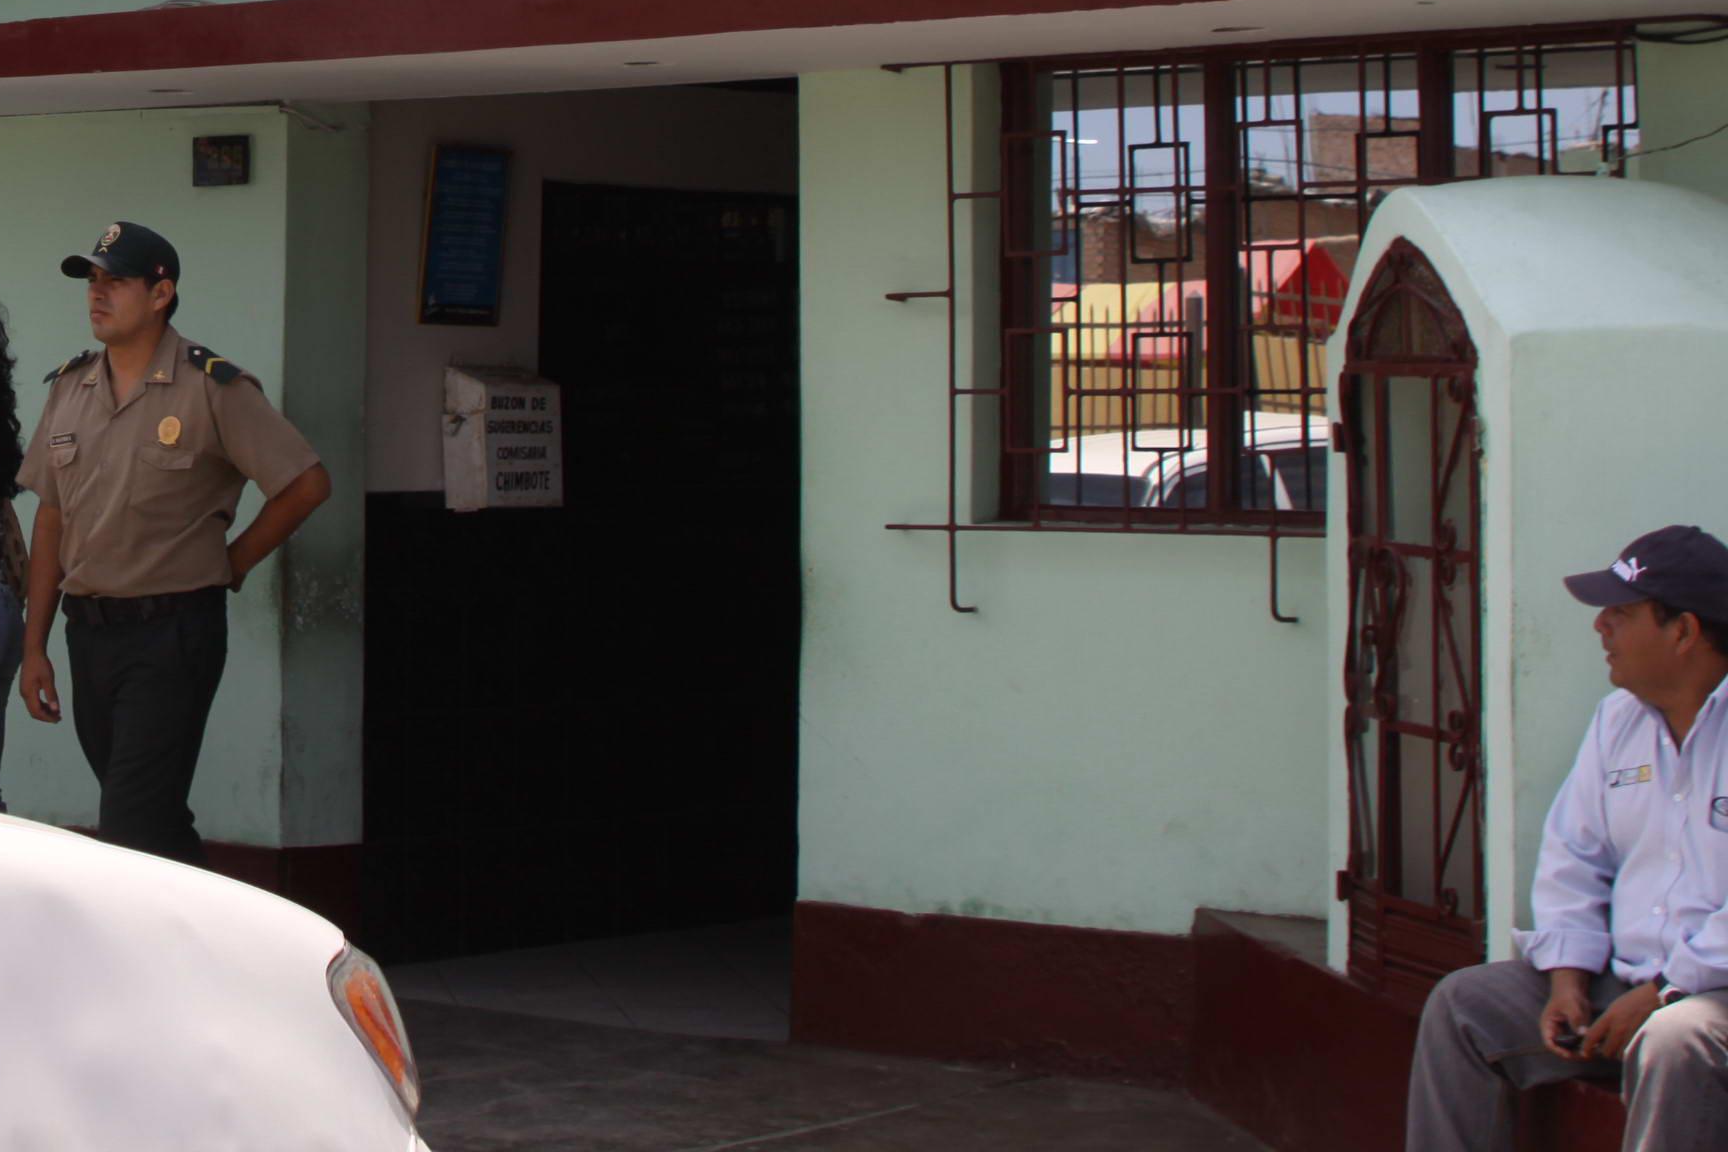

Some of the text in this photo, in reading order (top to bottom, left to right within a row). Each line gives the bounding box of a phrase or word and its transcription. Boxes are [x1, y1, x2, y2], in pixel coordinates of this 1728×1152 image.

[490, 396, 546, 410] BUZON DE
[495, 470, 550, 491] CHIMBOTE
